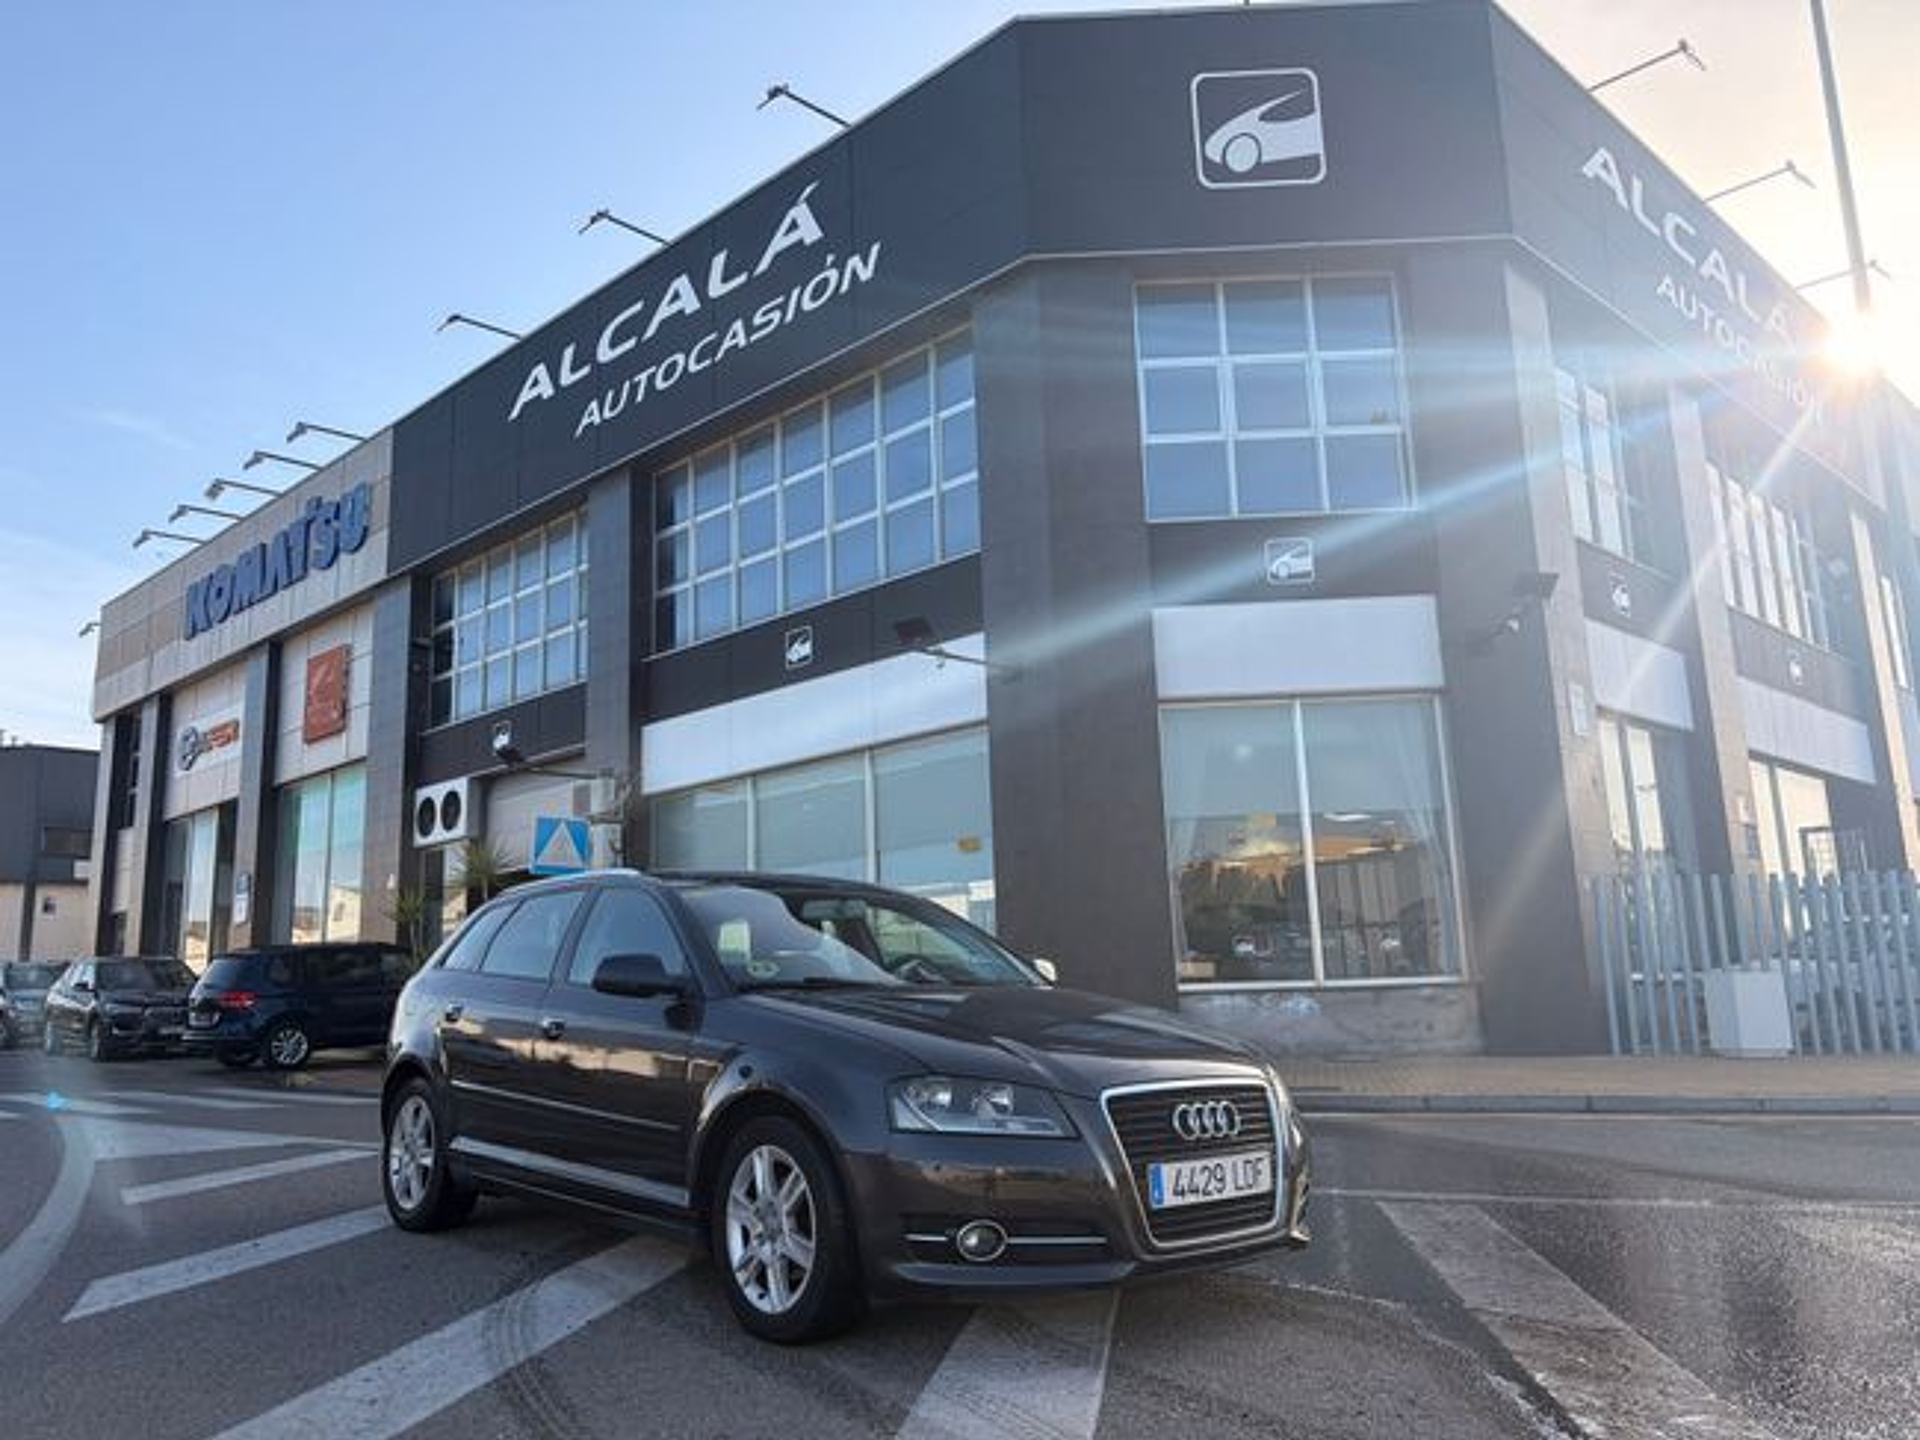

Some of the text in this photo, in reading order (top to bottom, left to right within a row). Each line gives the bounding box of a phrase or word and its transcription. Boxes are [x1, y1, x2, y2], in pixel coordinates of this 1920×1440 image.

[507, 181, 825, 422] ALCALÁ
[574, 242, 882, 437] AUTOCASIÓN
[185, 482, 373, 641] KOMATSU
[1172, 1163, 1227, 1198] 4429
